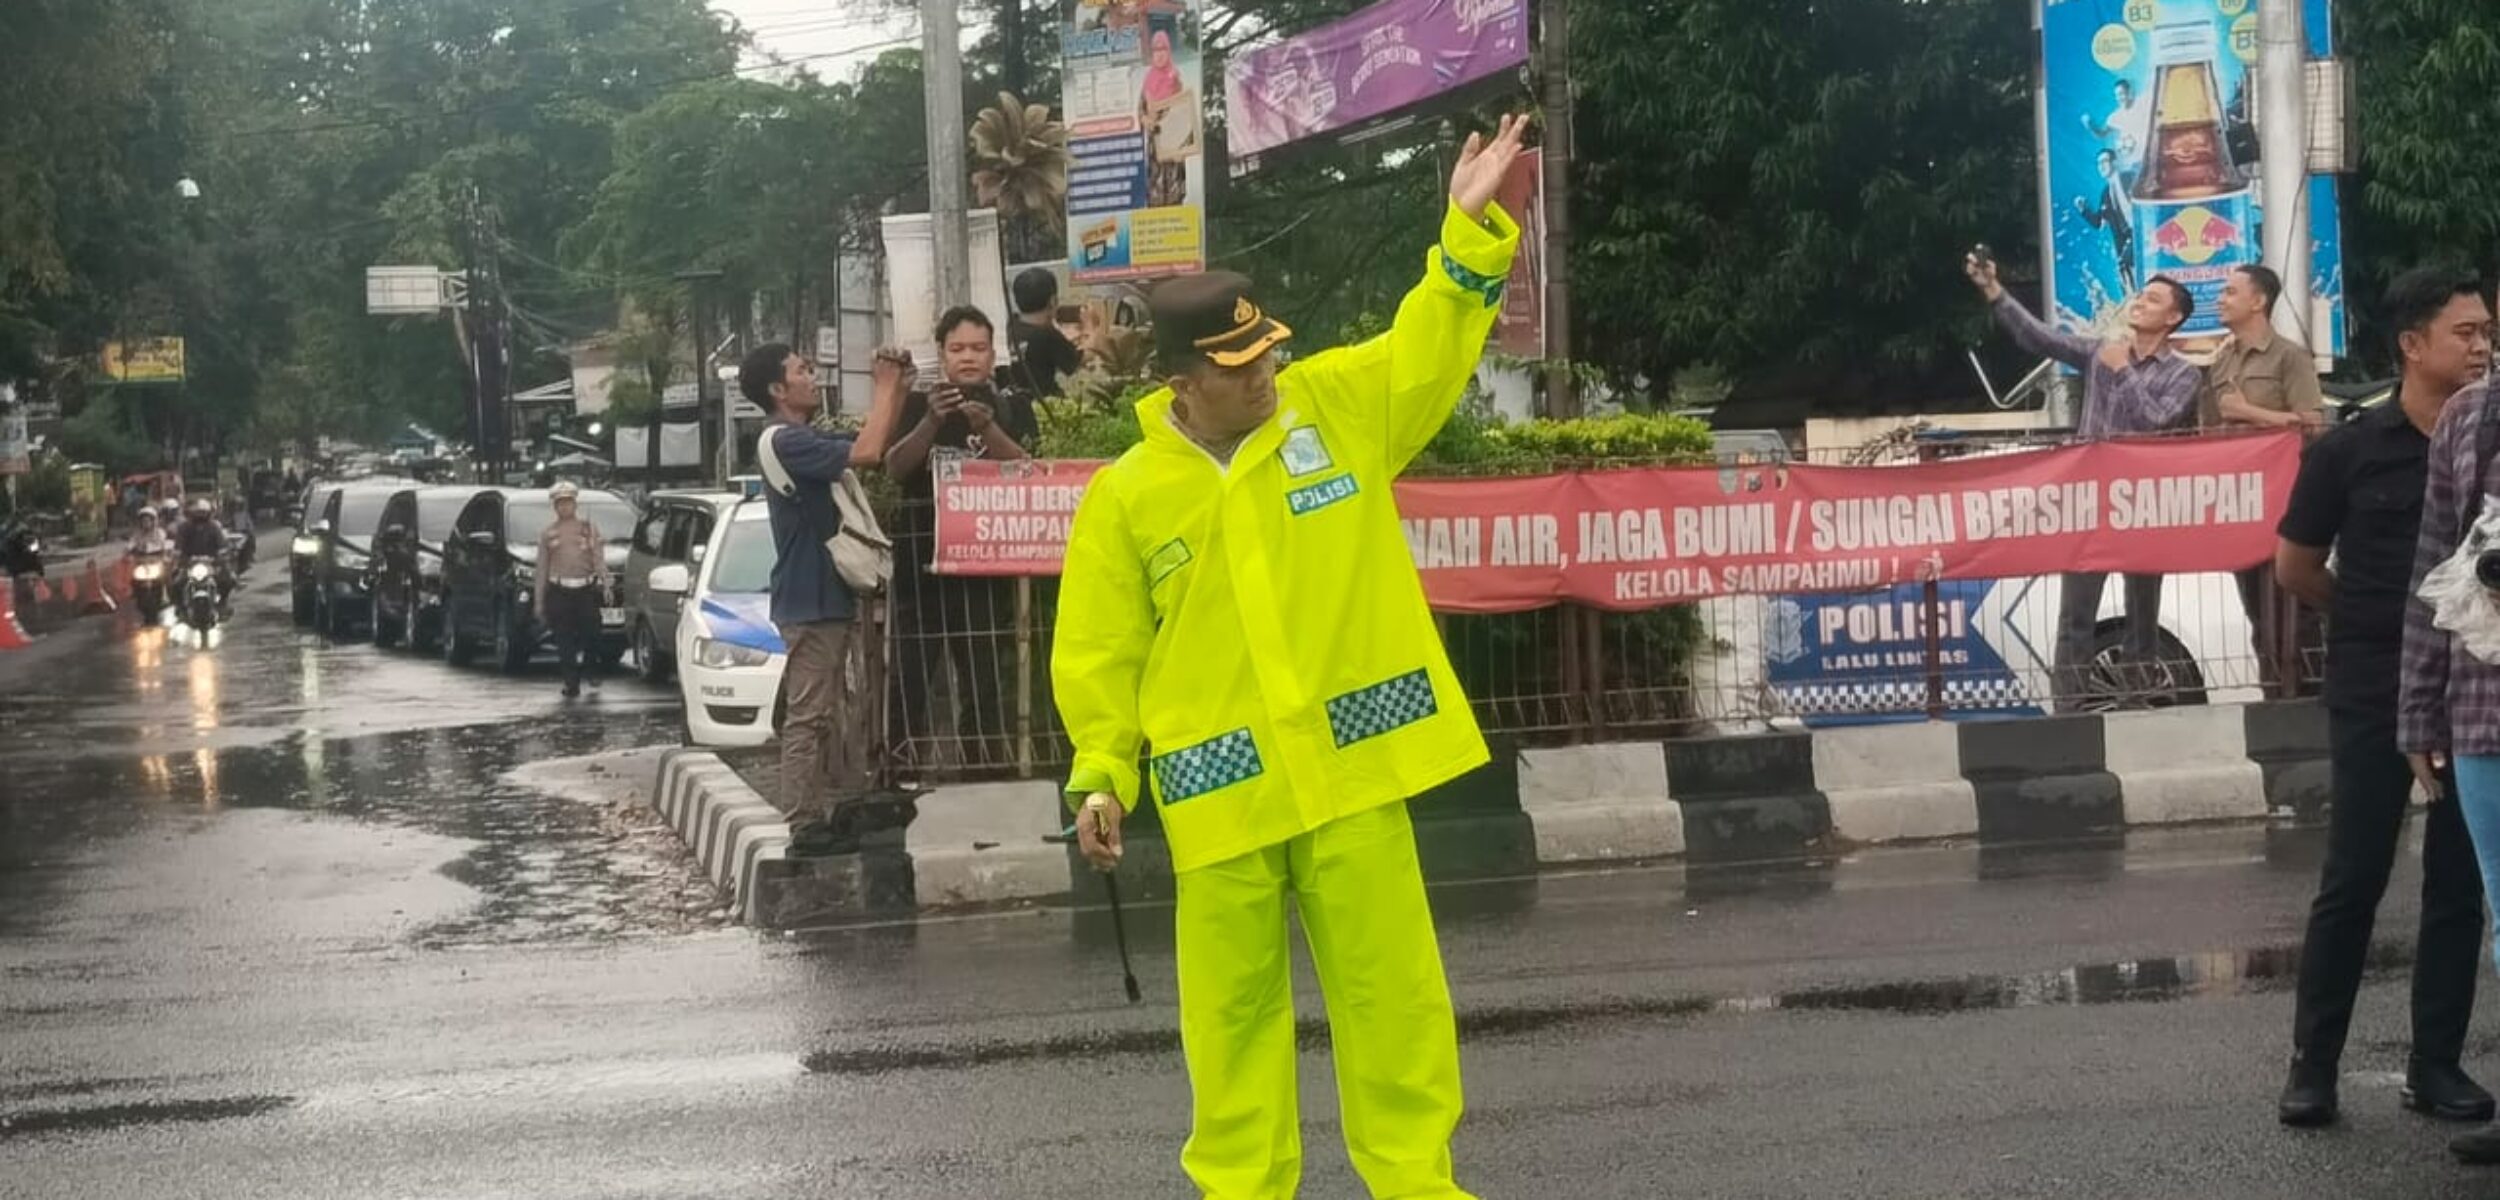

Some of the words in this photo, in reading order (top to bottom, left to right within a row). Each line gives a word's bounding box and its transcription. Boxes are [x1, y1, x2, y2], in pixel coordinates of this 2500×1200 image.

[2128, 4, 2153, 22] B3
[947, 485, 1025, 511] SUNGAI
[1291, 477, 1357, 514] POLISI
[1490, 514, 1568, 570] AIR,
[1576, 508, 1667, 563] JAGA
[1674, 502, 1777, 559] BUMI
[1785, 501, 1801, 554] /
[1811, 491, 1955, 552] SUNGAI
[1966, 481, 2098, 541] BERSIH
[2108, 472, 2264, 530] SAMPAH
[946, 544, 995, 560] KELOLA
[1615, 566, 1714, 600] KELOLA
[1723, 558, 1880, 593] SAMPAHMU
[1818, 600, 1966, 645] POLISI
[1821, 652, 1879, 670] LALU
[1885, 650, 1969, 667] LINAS
